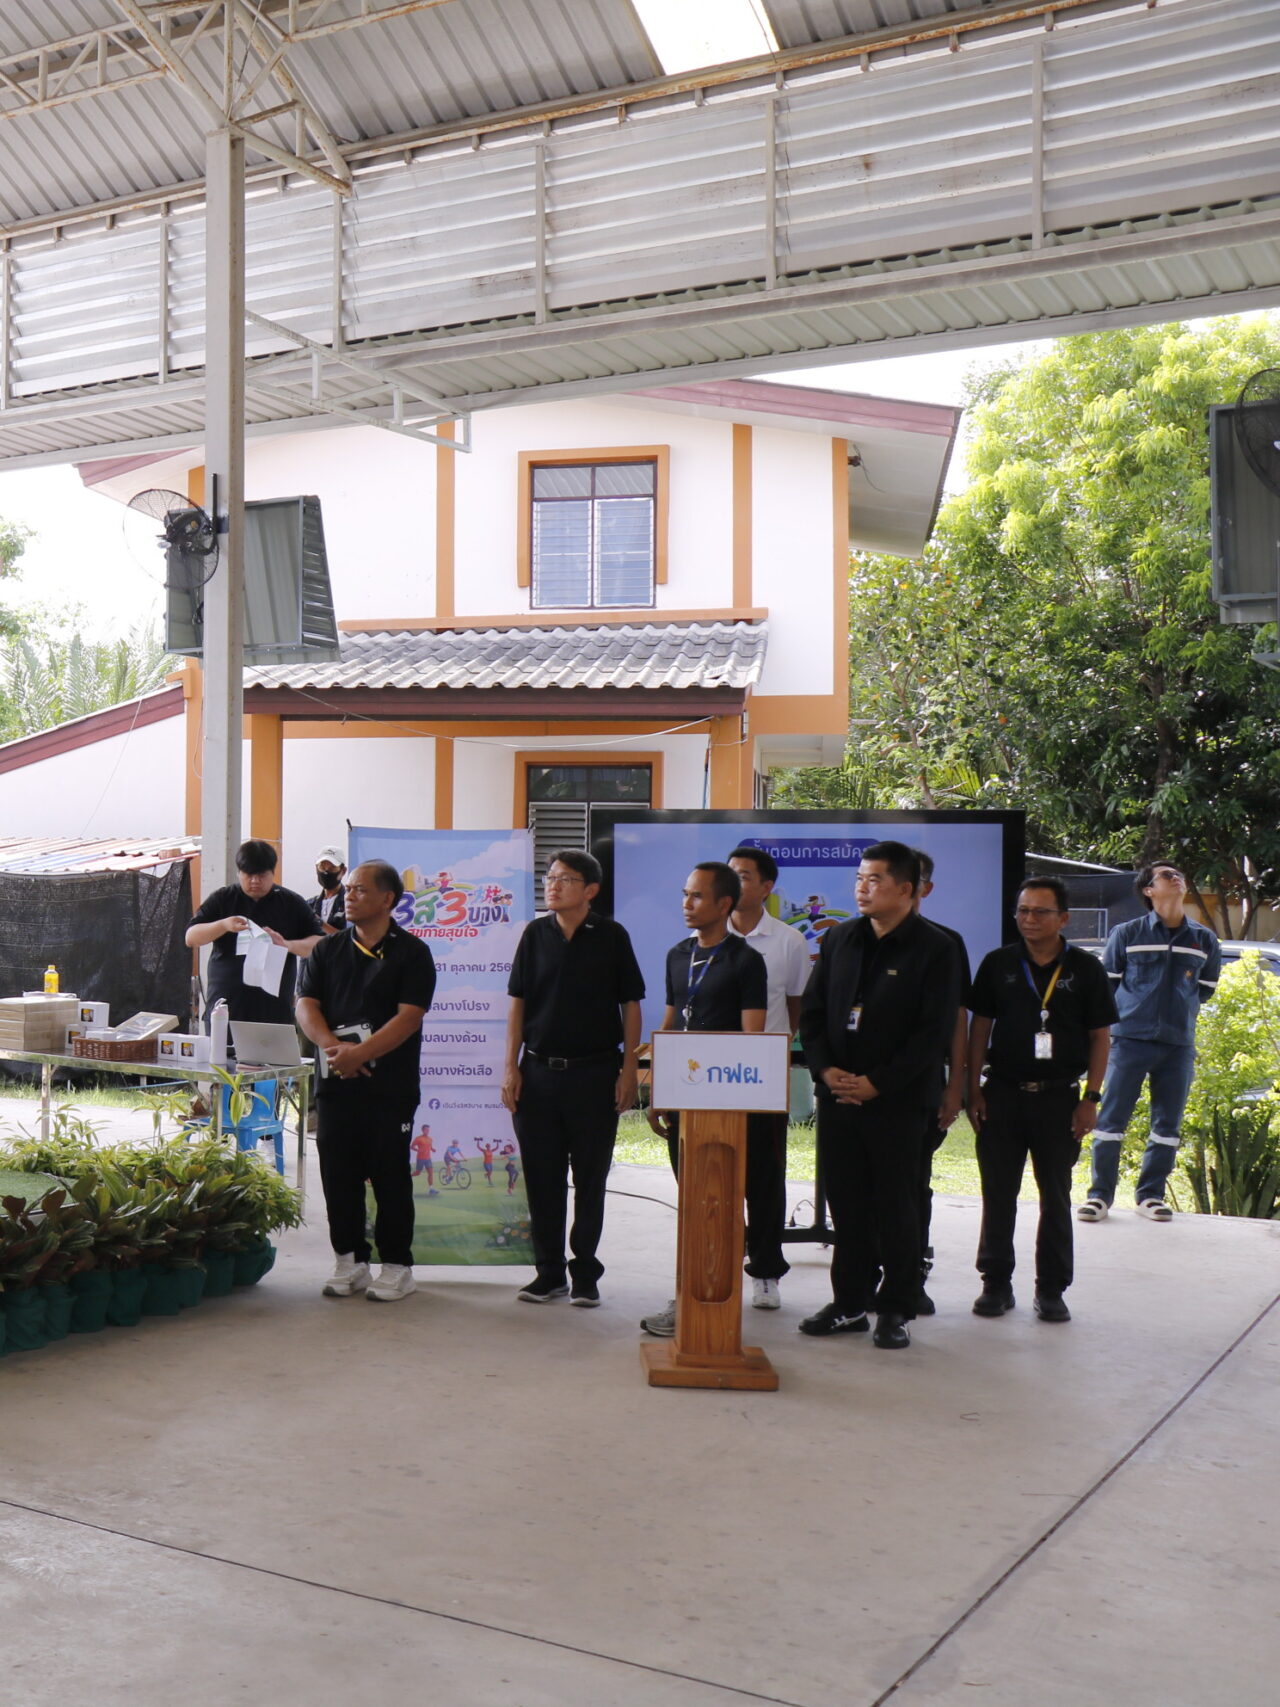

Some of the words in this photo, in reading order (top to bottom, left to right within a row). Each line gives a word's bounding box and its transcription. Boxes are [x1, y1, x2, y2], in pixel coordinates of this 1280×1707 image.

[450, 963, 486, 975] ตุลาคม
[490, 962, 512, 973] 256
[707, 1063, 763, 1084] กฟผ.
